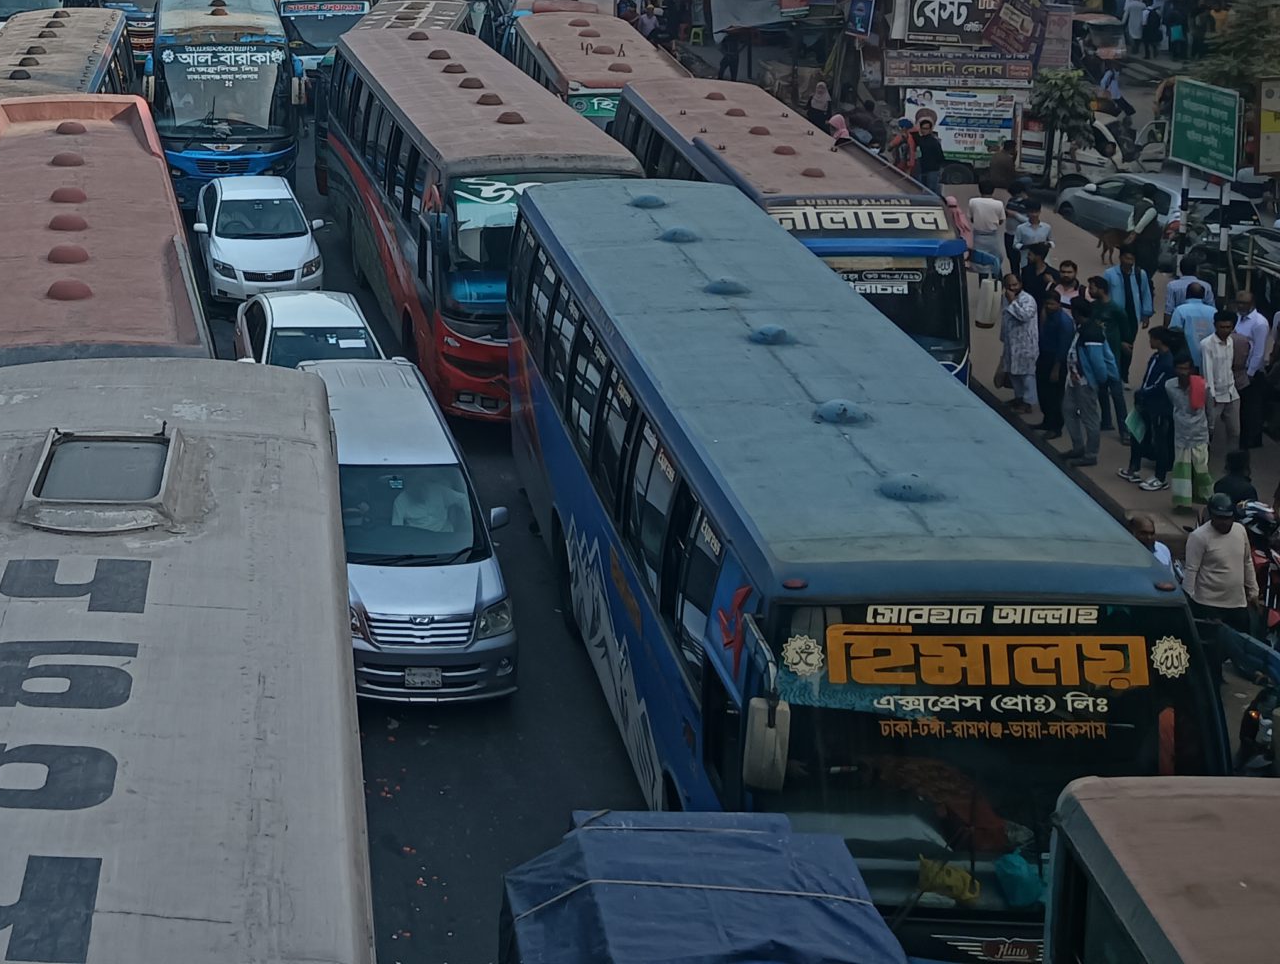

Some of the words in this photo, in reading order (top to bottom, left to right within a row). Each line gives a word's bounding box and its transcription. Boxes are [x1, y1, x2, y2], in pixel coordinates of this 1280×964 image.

[175, 51, 271, 66] আল-বারাকা
[911, 60, 956, 75] মাদানি
[961, 62, 1004, 76] নেসাব
[701, 516, 722, 556] Express
[866, 605, 985, 625] সোবহান
[991, 605, 1100, 625] আল্লাহ
[825, 623, 1151, 690] হিমালয়
[873, 694, 982, 713] এক্সপ্রেস
[1062, 692, 1109, 714] লিঃ
[994, 943, 1030, 959] Hino
